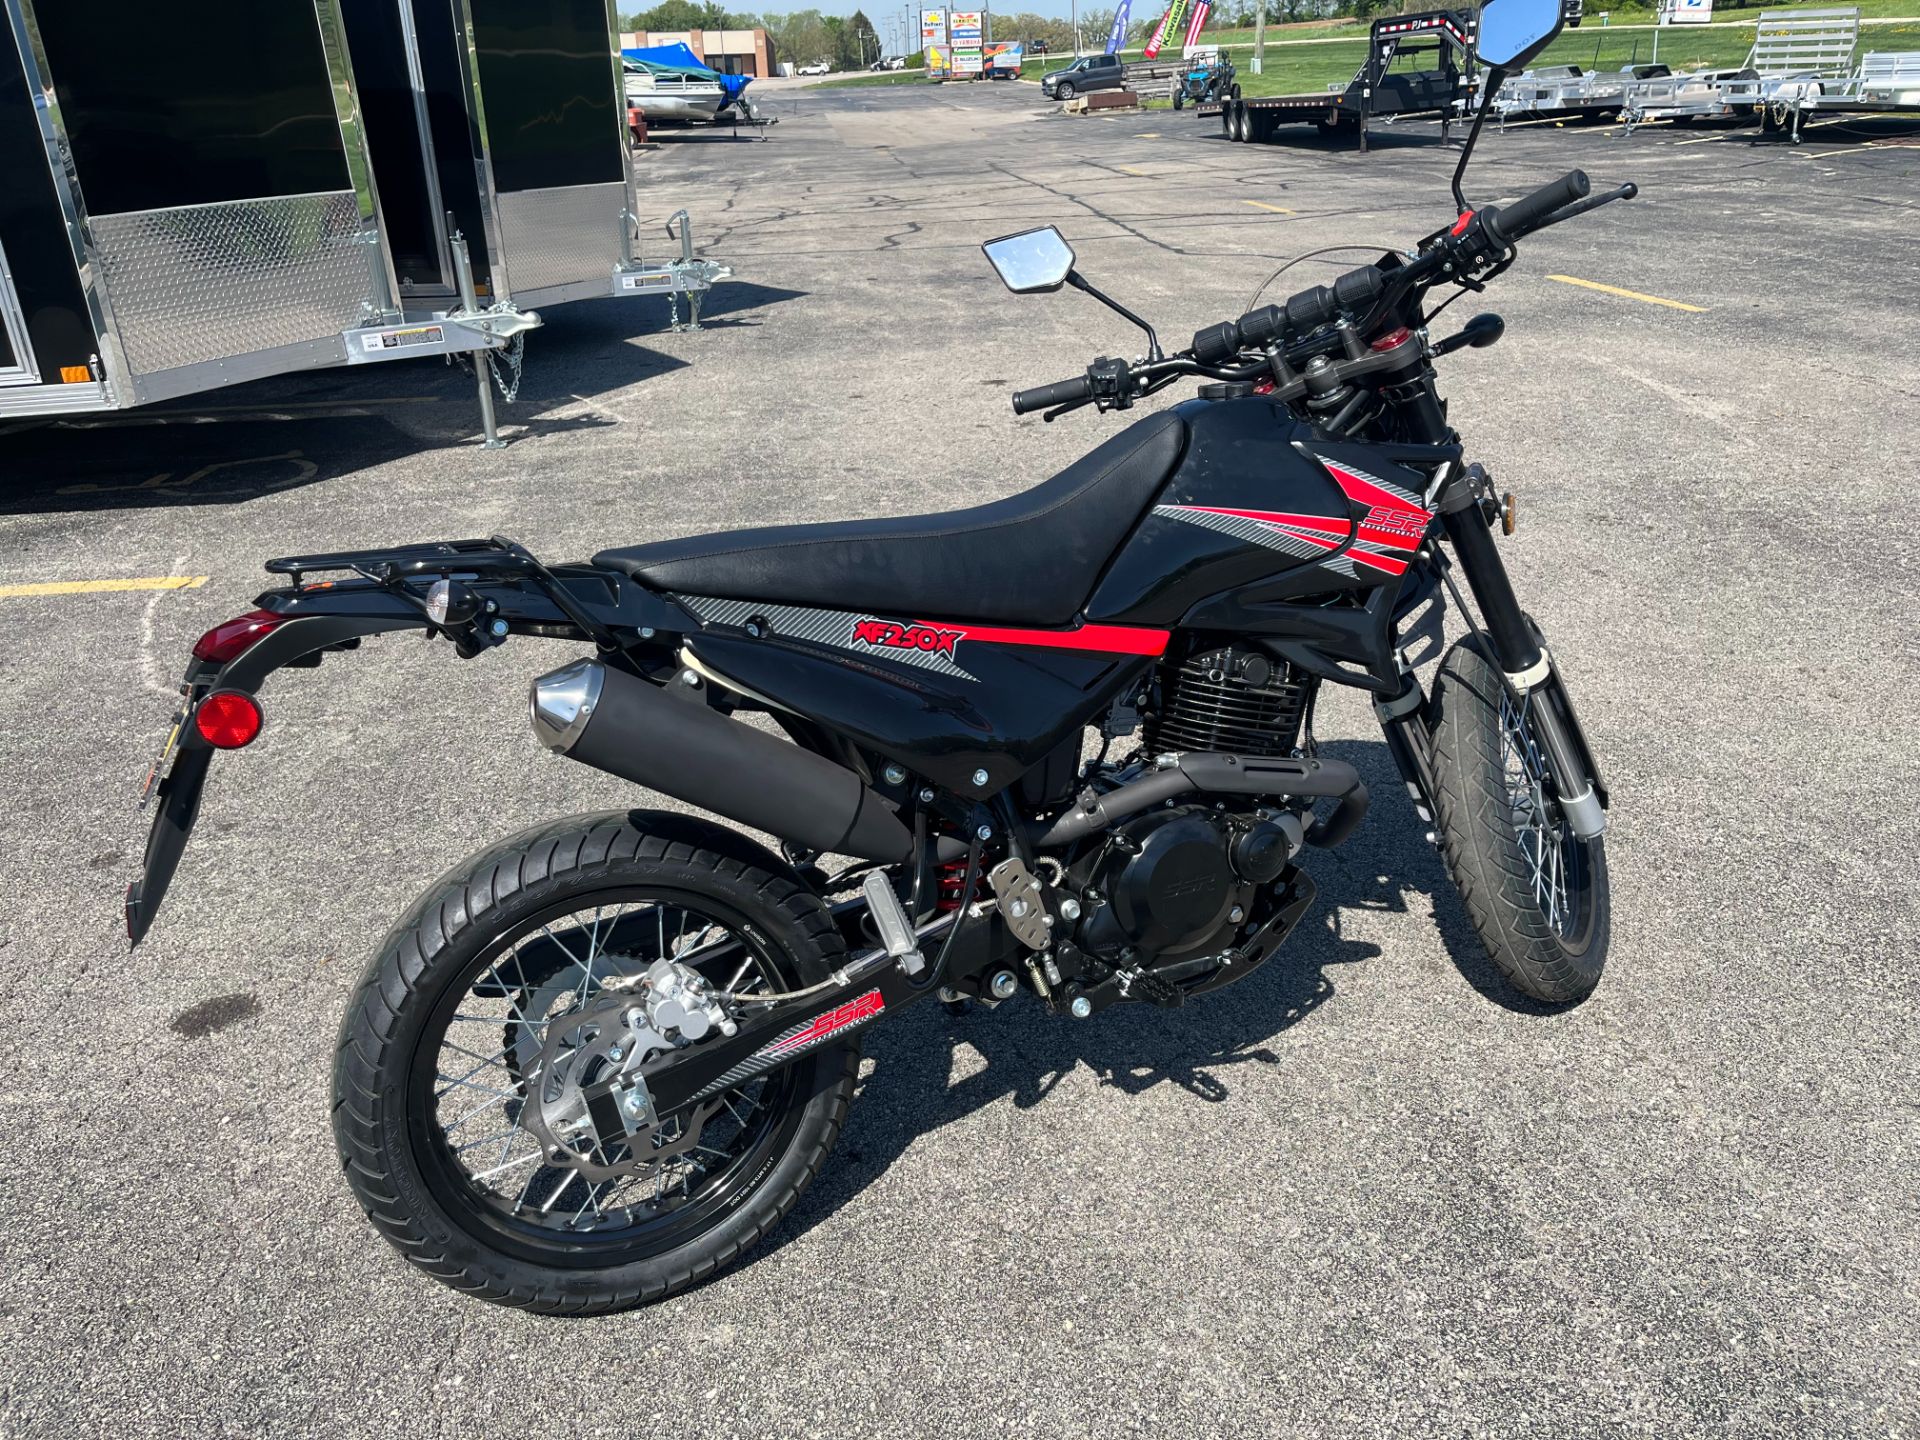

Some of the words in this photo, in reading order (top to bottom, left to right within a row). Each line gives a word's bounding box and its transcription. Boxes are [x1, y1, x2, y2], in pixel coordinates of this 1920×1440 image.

[1411, 20, 1422, 30] PJ
[1514, 33, 1537, 51] DOT
[1362, 505, 1430, 539] SSR
[851, 618, 961, 657] XF250X
[811, 990, 878, 1041] SSR
